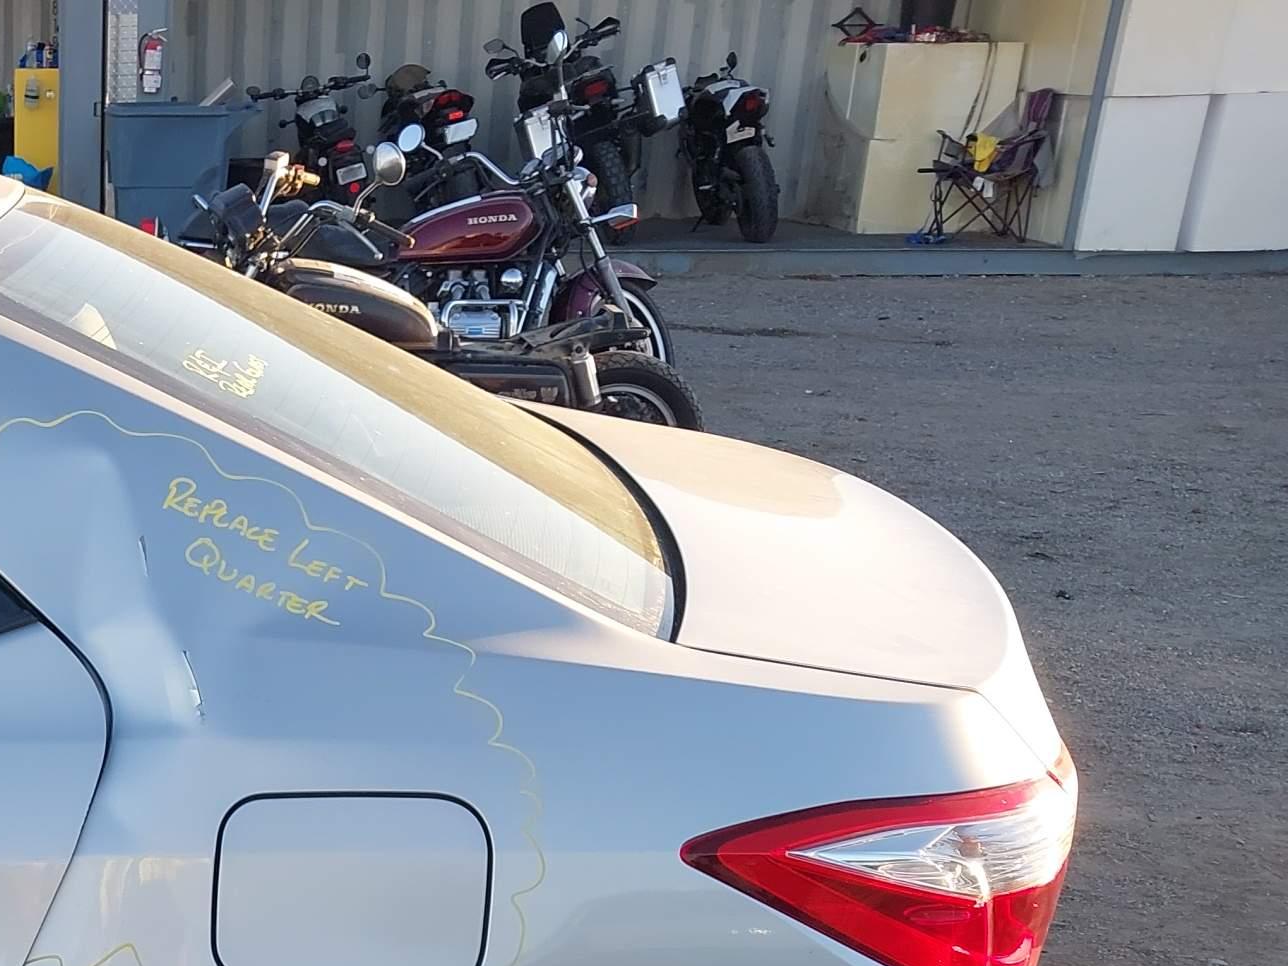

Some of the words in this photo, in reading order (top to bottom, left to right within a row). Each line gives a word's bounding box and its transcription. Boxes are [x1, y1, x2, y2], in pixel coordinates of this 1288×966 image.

[467, 213, 518, 225] HONDA
[309, 302, 362, 315] ONDA
[162, 477, 280, 551] REPLACE
[288, 538, 369, 591] LEFT
[184, 538, 340, 626] QUARTER
